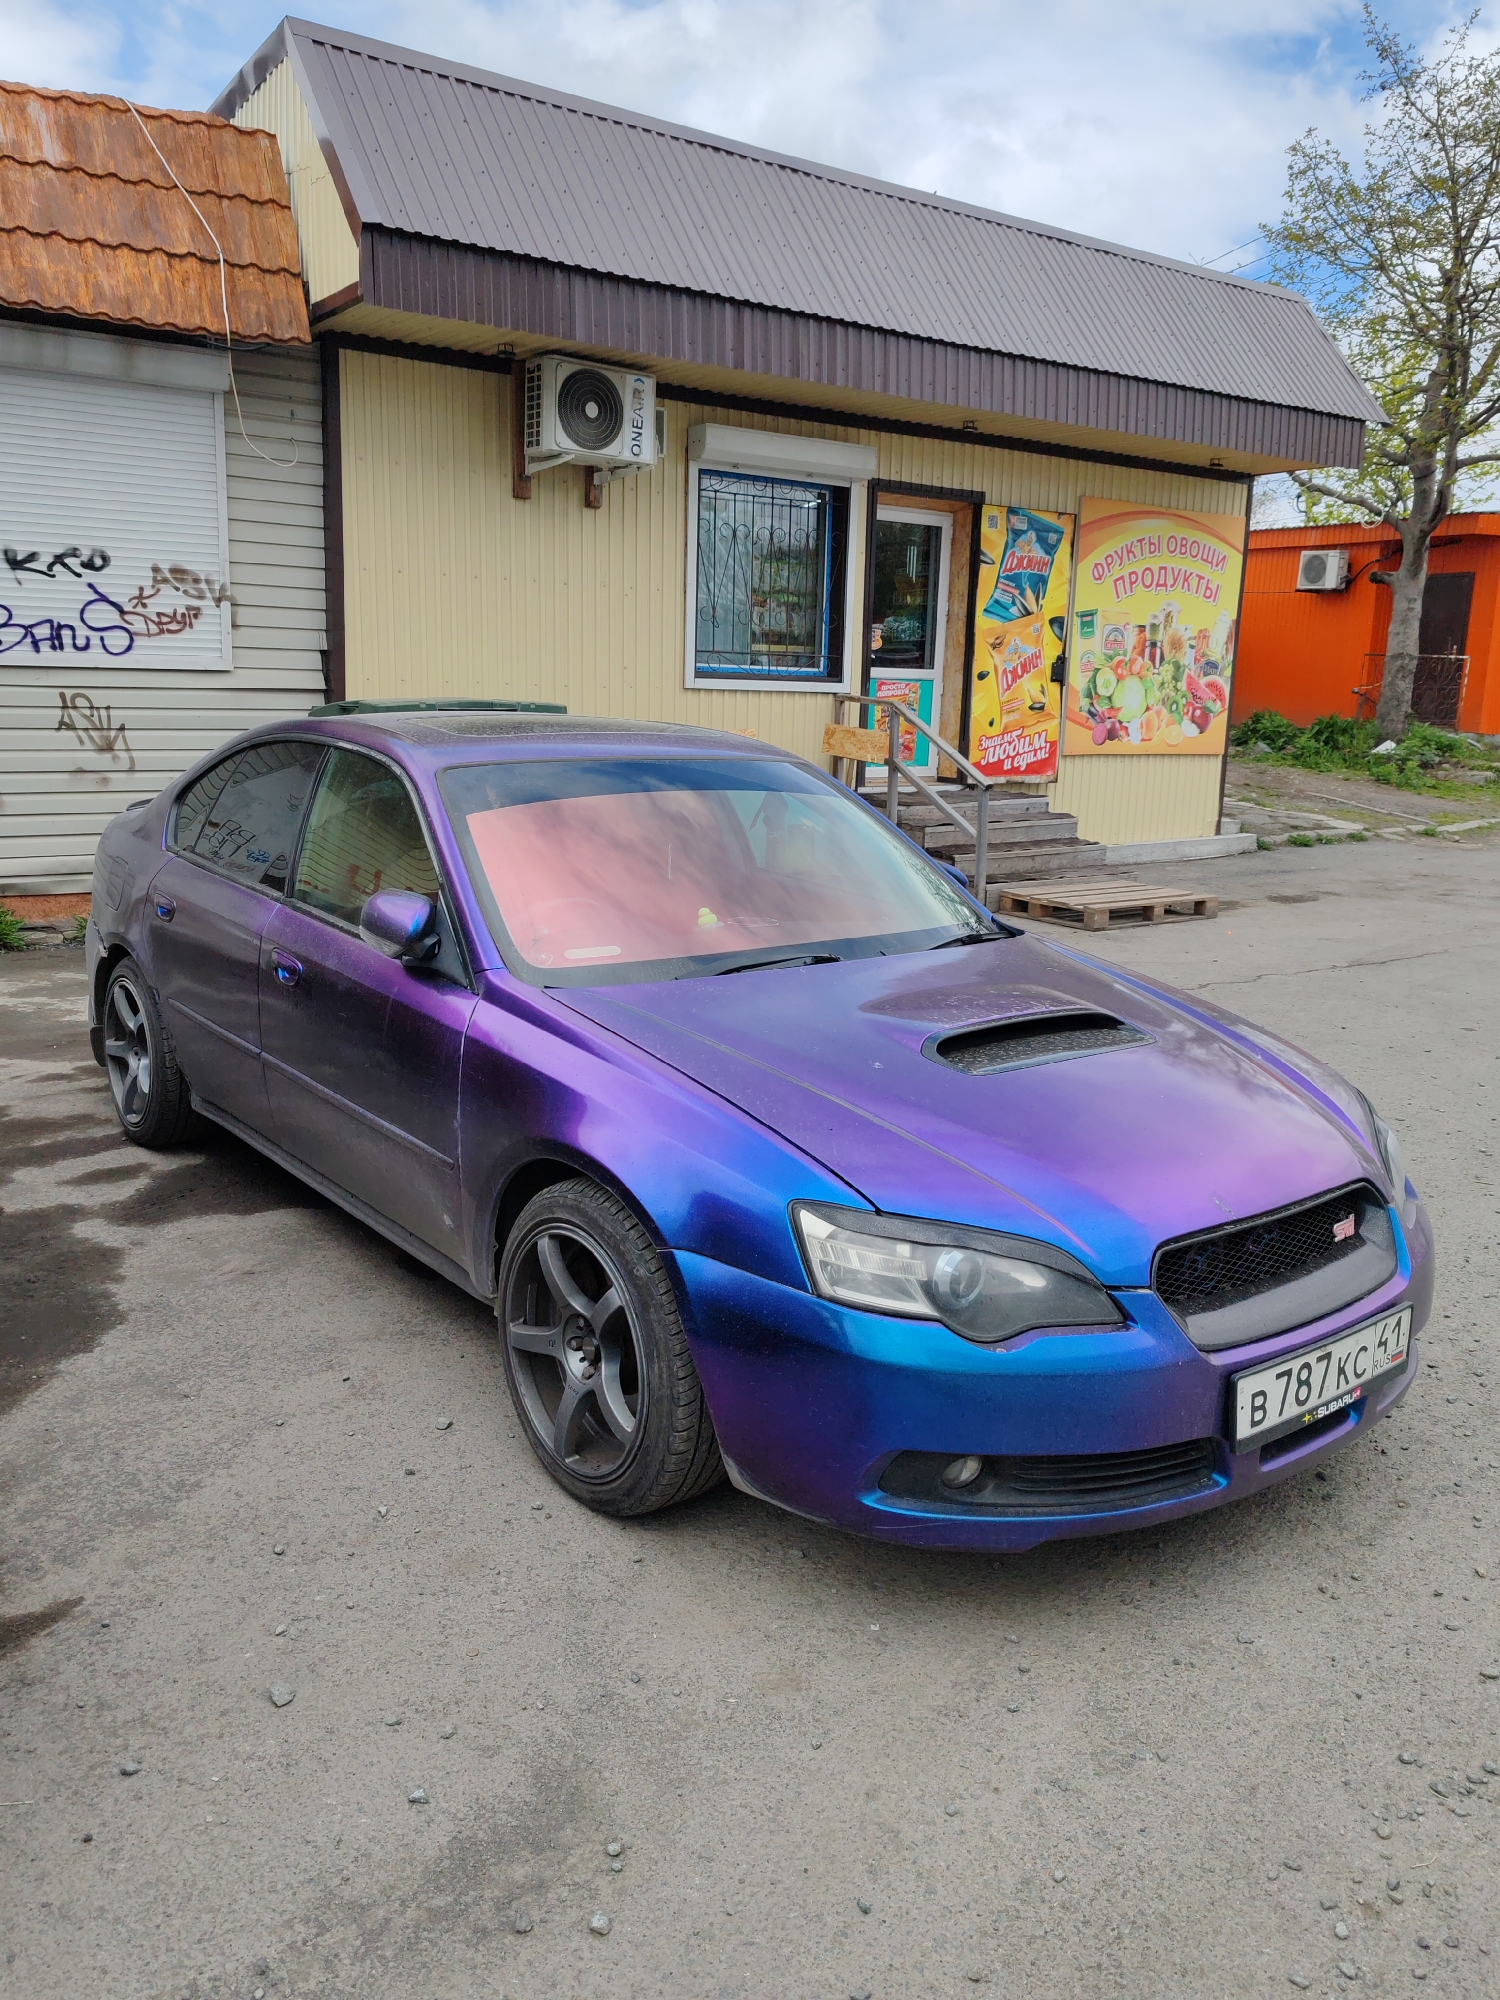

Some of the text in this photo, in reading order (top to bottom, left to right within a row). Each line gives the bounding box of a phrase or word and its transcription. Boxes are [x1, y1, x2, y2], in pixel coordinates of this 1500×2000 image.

[1092, 534, 1228, 582] ФРУКТЫ ОВОЩИ
[1112, 565, 1221, 604] ПРОДУКТЫ
[881, 683, 906, 691] ПРОСТО
[1003, 742, 1051, 771] и едим!
[1376, 1314, 1403, 1354] 41
[1373, 1353, 1391, 1372] RUS
[1317, 1391, 1355, 1419] SUBARU
